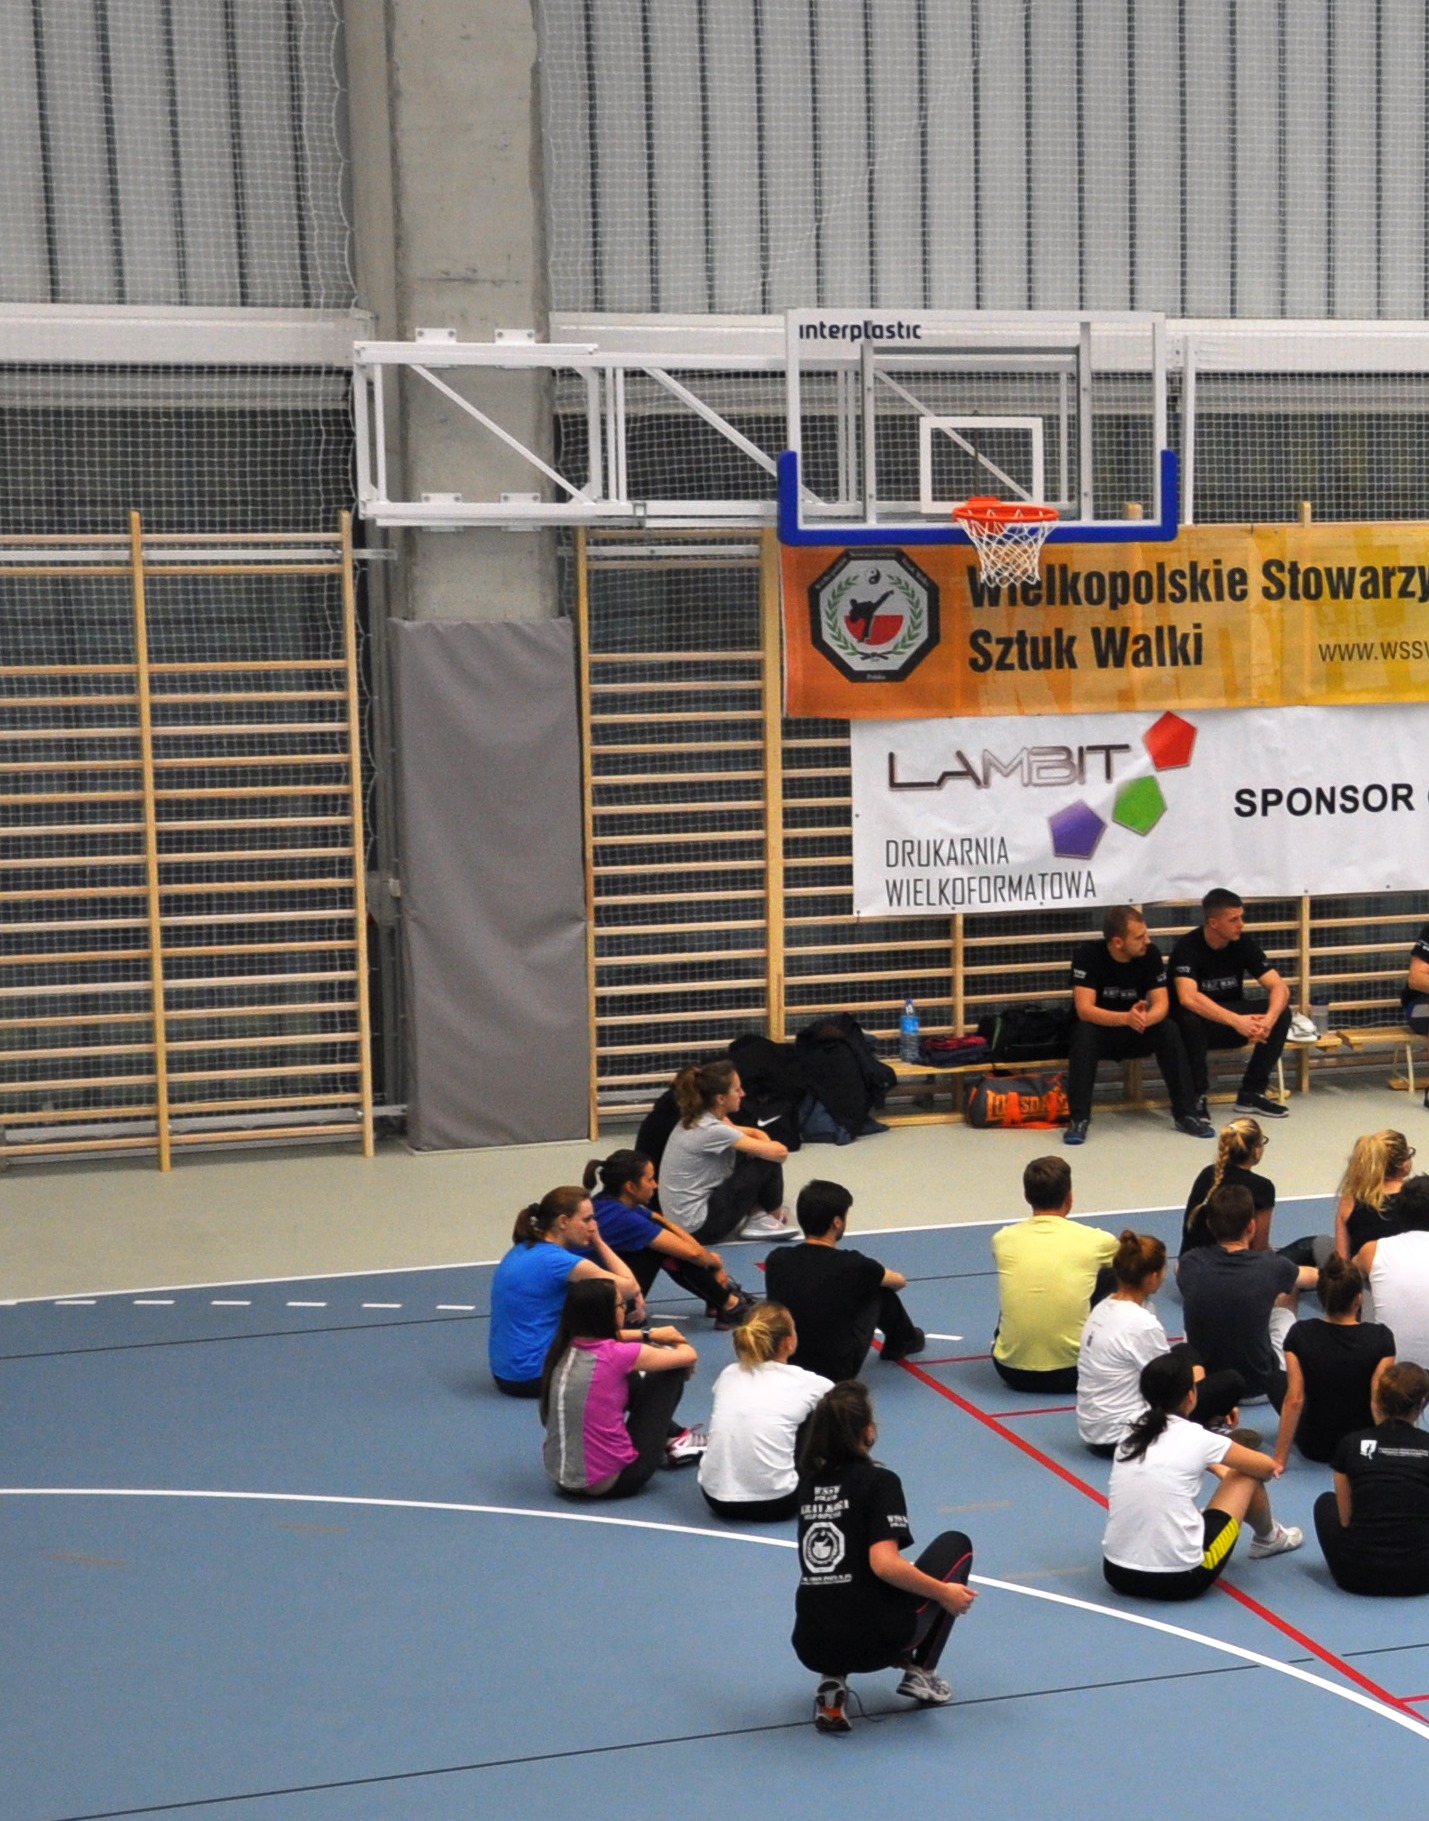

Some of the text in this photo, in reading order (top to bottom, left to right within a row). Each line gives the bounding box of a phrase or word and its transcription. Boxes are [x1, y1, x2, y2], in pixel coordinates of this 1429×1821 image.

[799, 320, 922, 342] interplastic
[967, 559, 1248, 610] Wielkopolskie
[968, 623, 1203, 673] Sztuk Walki
[888, 743, 1130, 791] LAMBIT
[1233, 782, 1415, 818] SPONSOR
[886, 837, 1009, 868] DRUKARNIA
[886, 870, 1097, 907] WIELKOFORMATOWA
